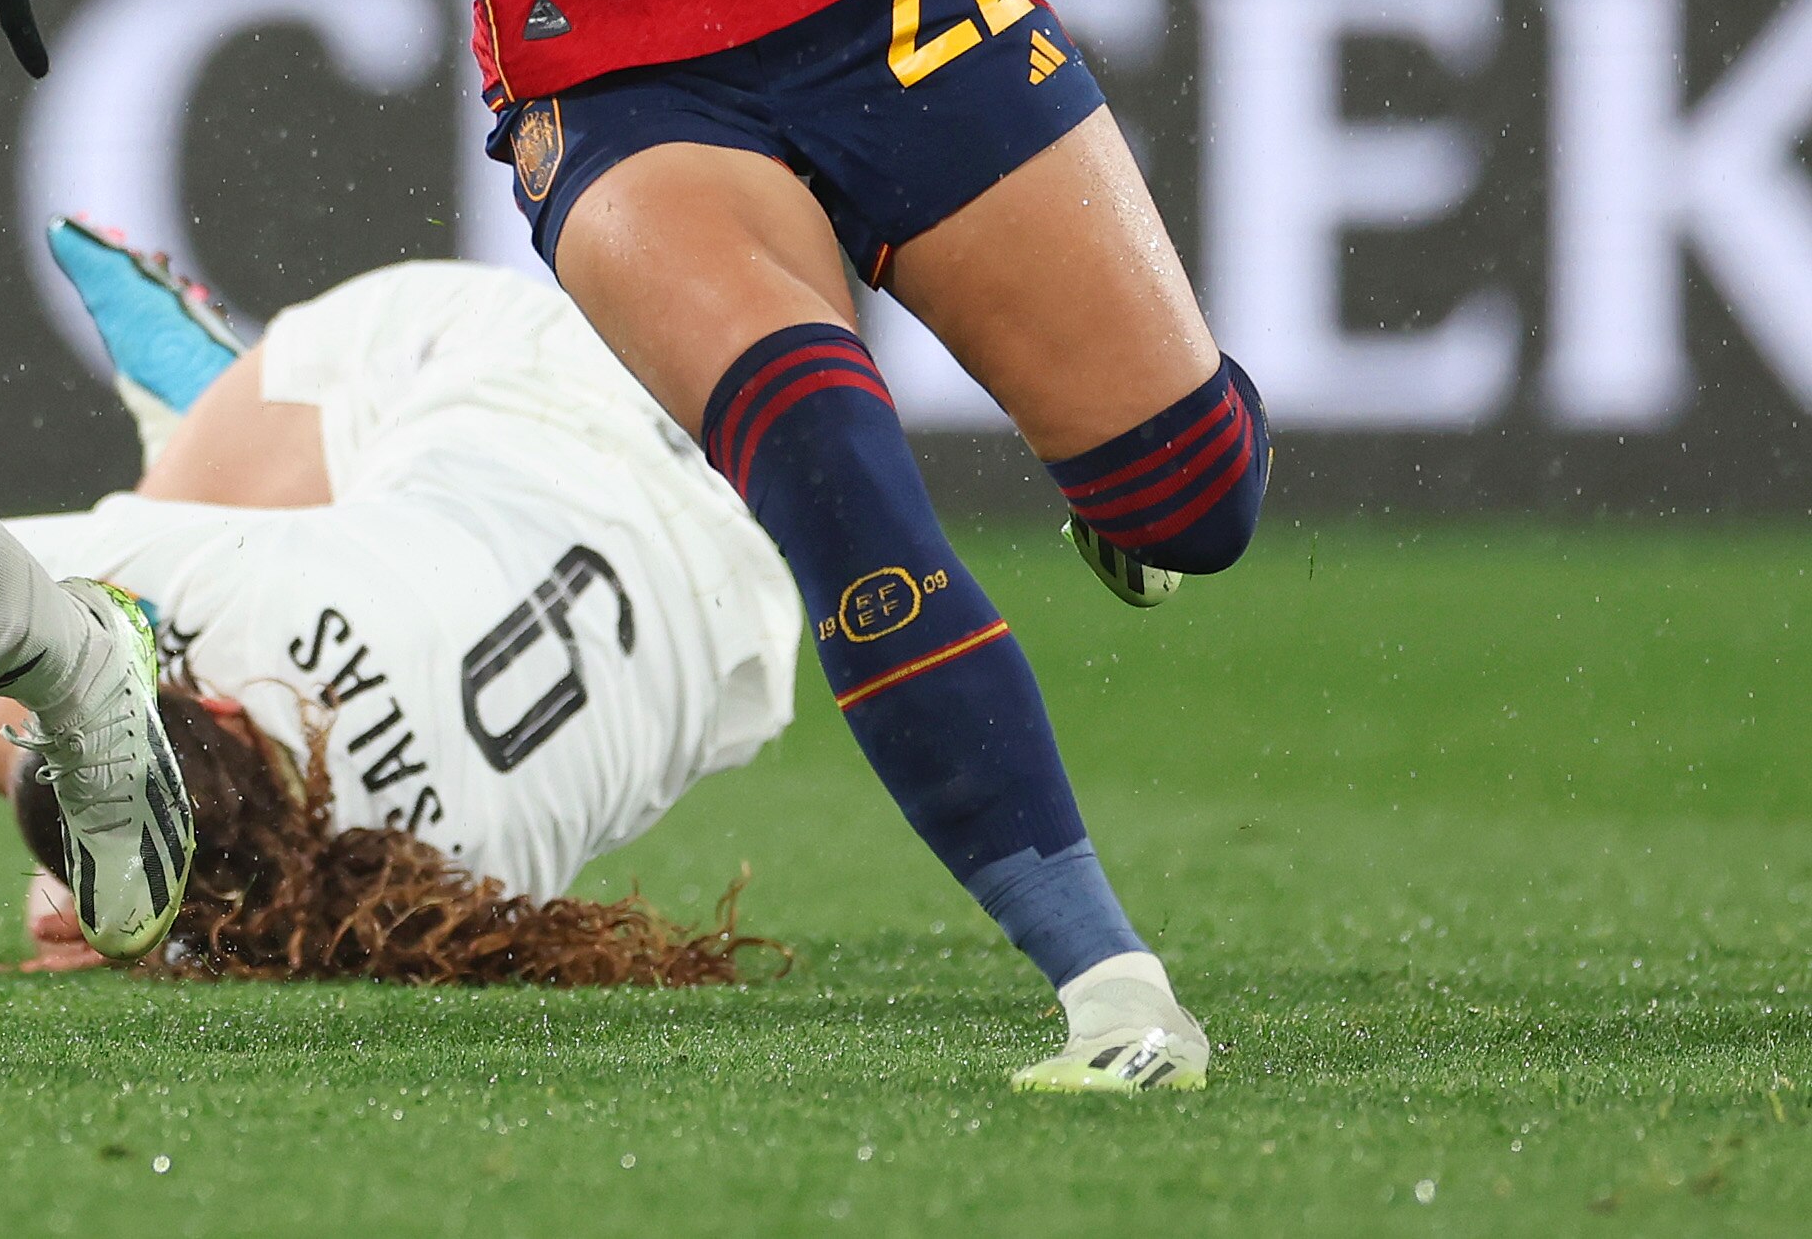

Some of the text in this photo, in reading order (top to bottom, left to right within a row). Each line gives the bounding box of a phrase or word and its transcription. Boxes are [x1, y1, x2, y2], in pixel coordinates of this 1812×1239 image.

[461, 543, 635, 773] 9
[922, 568, 949, 594] 09
[289, 608, 443, 833] SALAS
